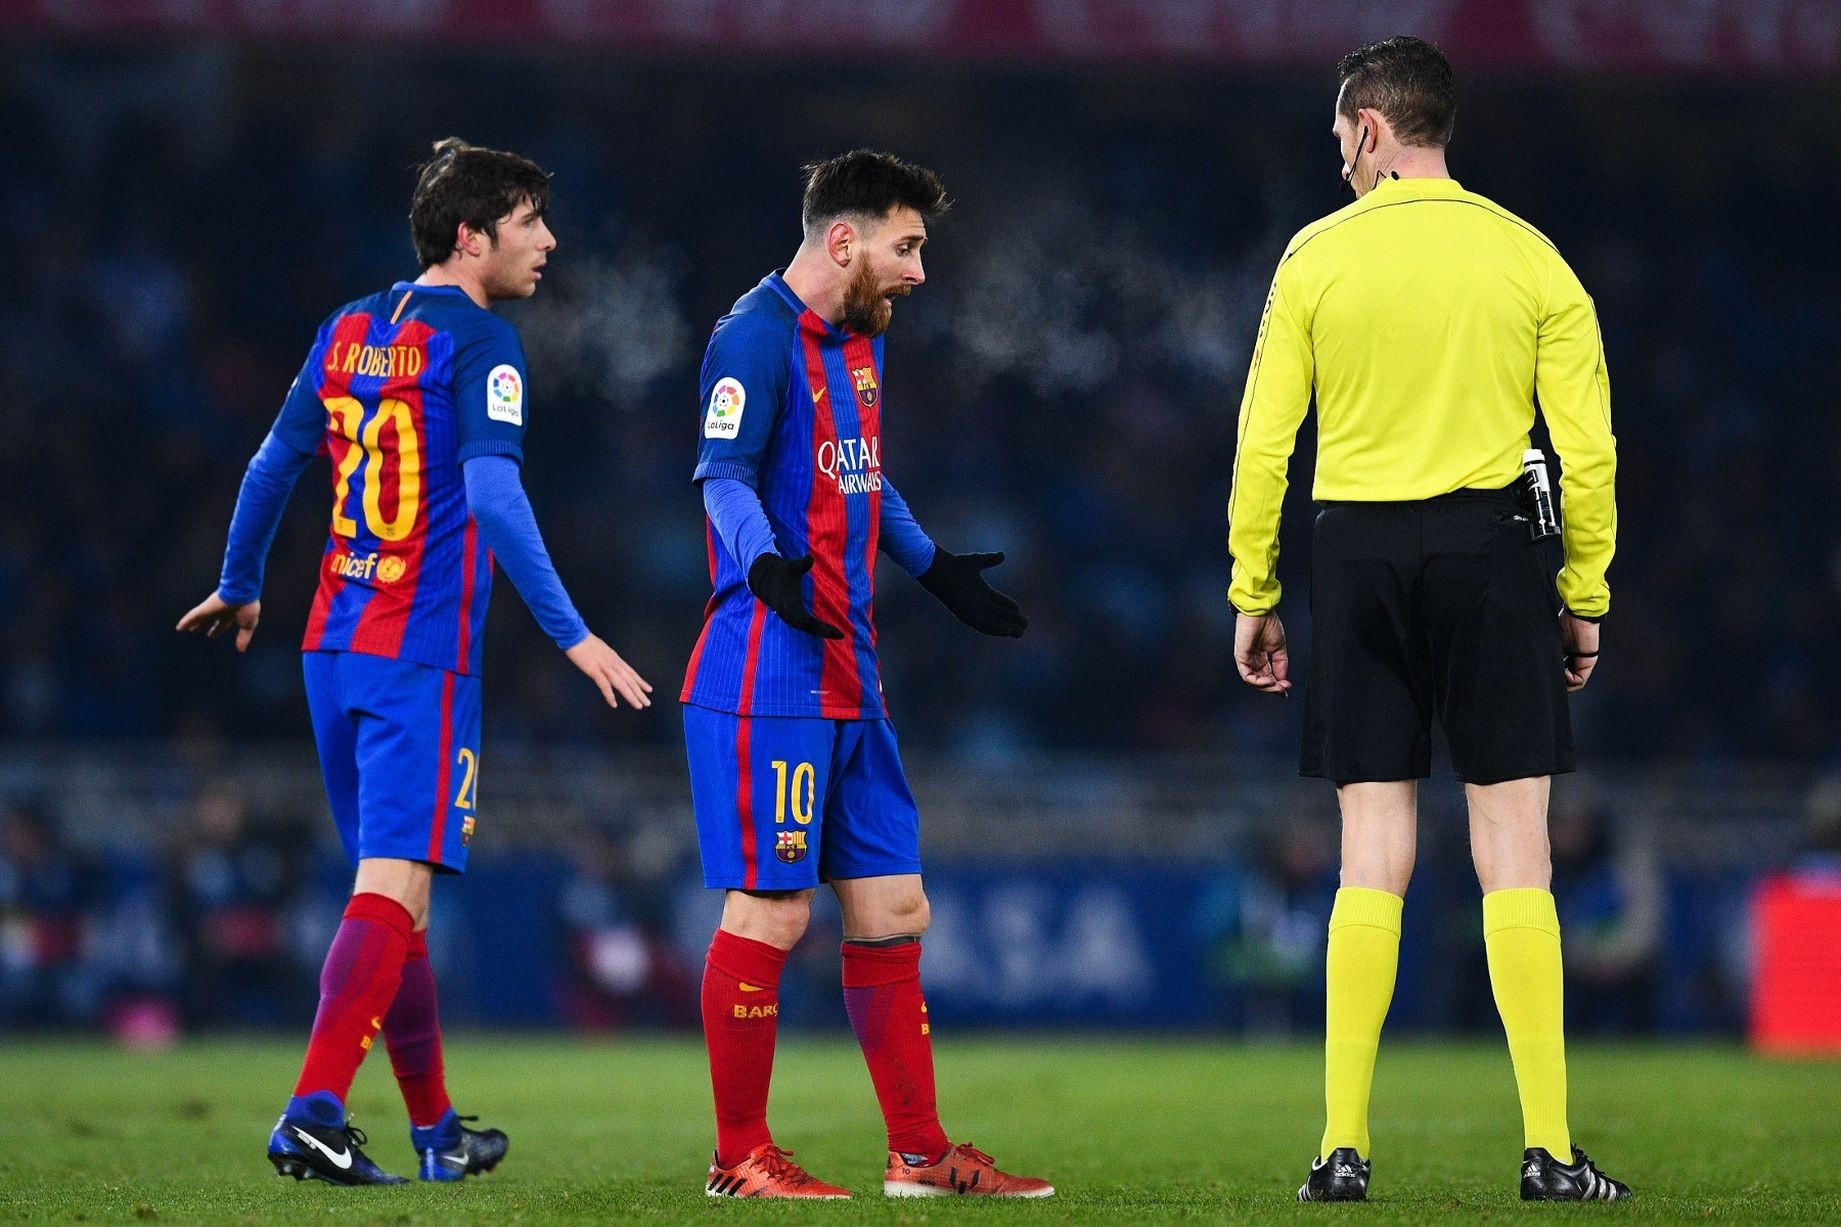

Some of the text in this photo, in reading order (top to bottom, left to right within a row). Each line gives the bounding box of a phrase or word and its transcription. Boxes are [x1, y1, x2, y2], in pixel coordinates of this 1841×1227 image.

[327, 341, 421, 377] S. ROBERTO
[707, 420, 735, 431] LaLiga
[323, 396, 420, 542] 20
[817, 436, 881, 480] QATAR
[330, 551, 378, 579] nicef
[454, 747, 480, 810] 2
[771, 760, 815, 825] 10
